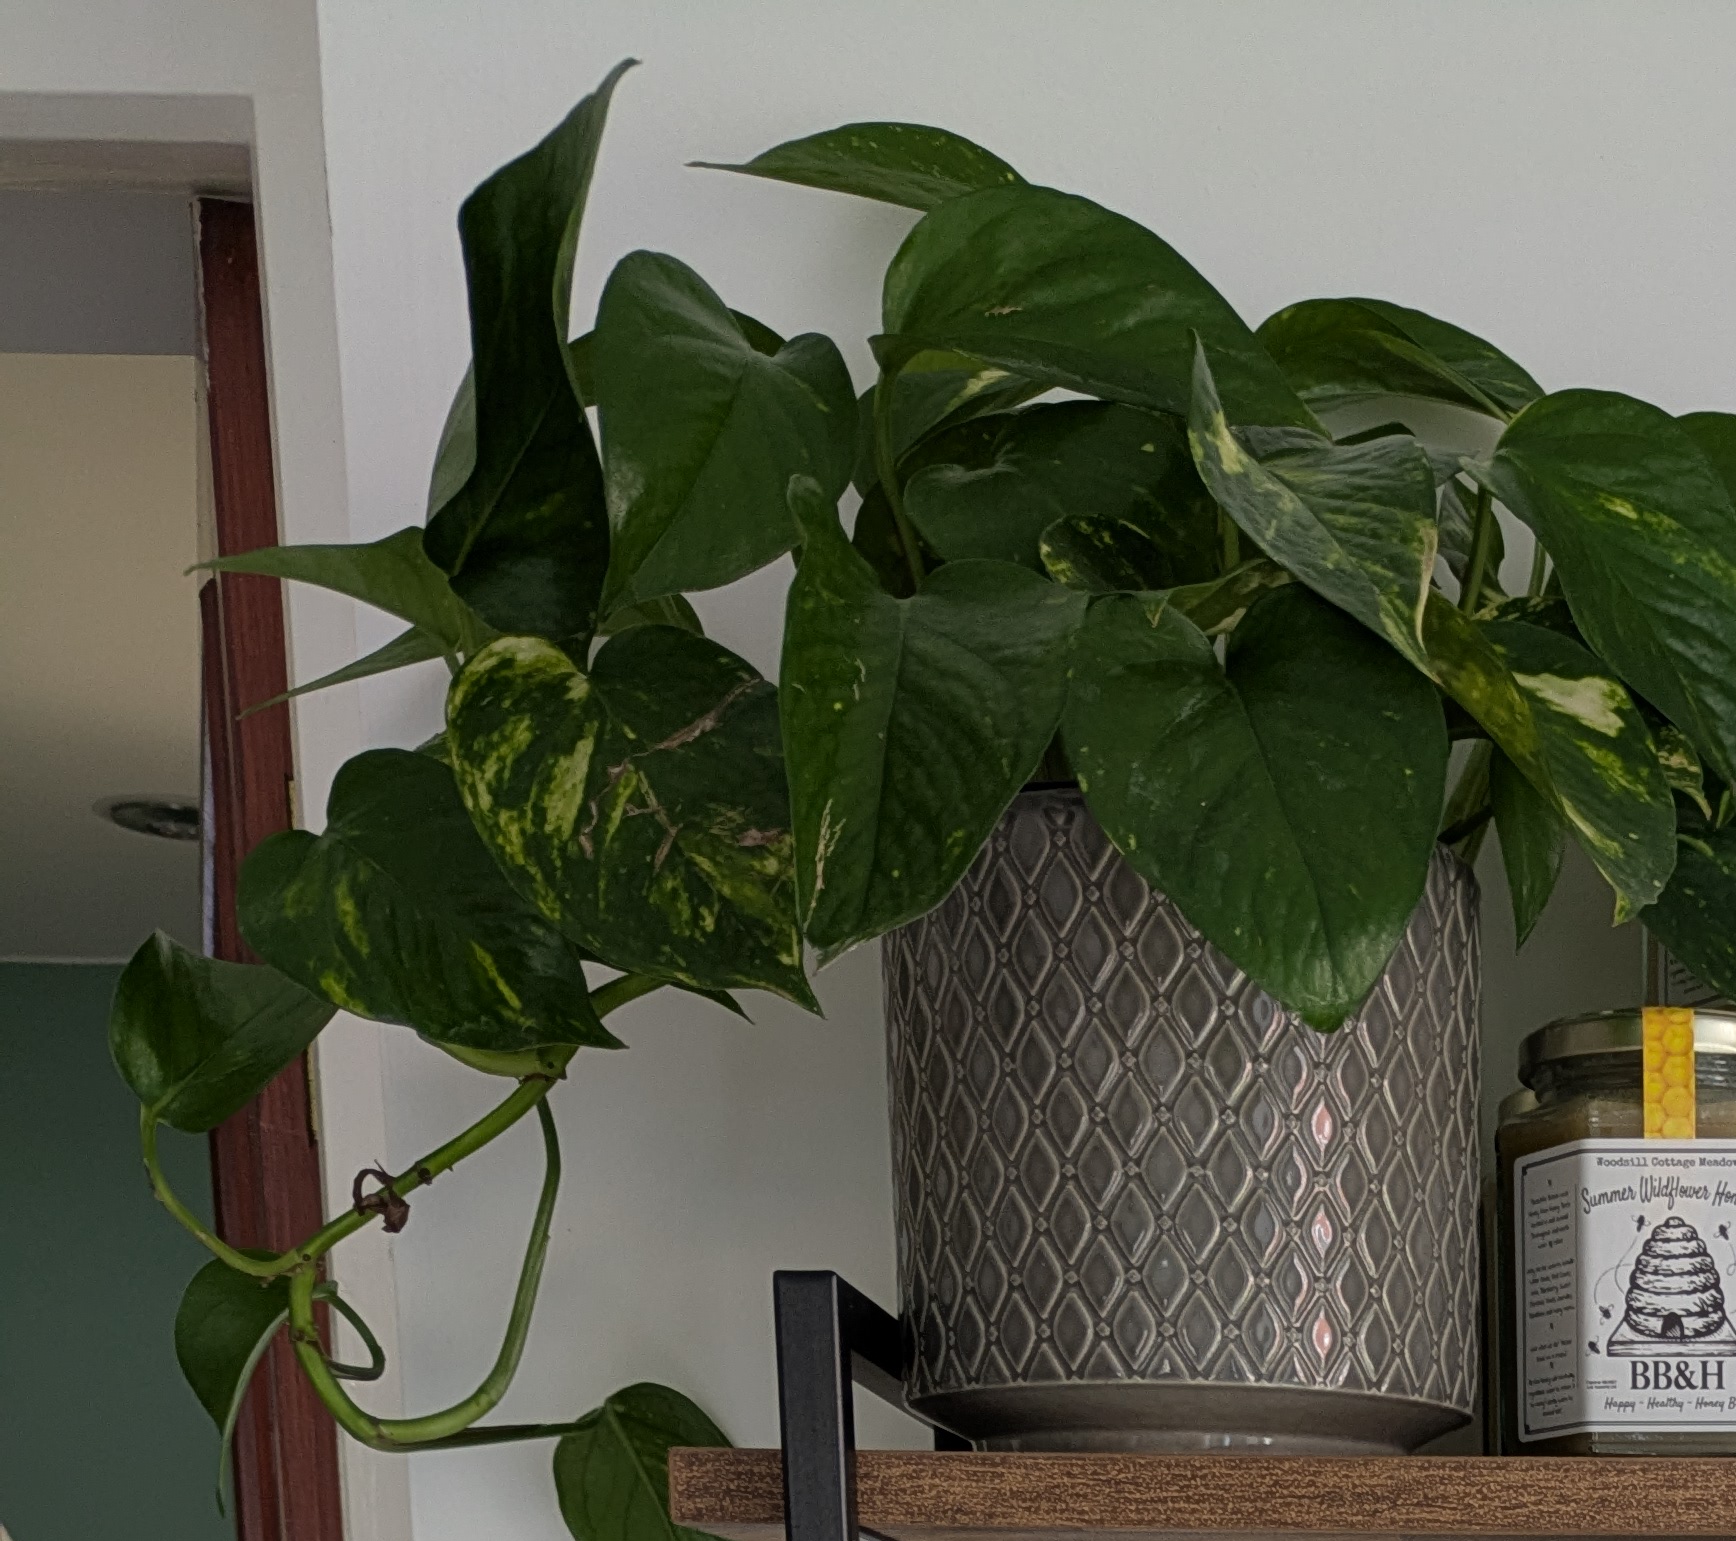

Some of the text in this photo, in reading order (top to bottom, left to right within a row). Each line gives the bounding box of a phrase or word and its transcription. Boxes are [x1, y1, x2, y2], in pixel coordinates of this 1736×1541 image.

[1651, 1157, 1696, 1169] Cottage
[1581, 1187, 1637, 1215] Summer
[1639, 1175, 1711, 1211] Wildflower
[1629, 1360, 1726, 1391] BB&H
[1604, 1397, 1636, 1413] Happy
[1646, 1396, 1684, 1413] Healthy
[1694, 1396, 1725, 1413] Honey
